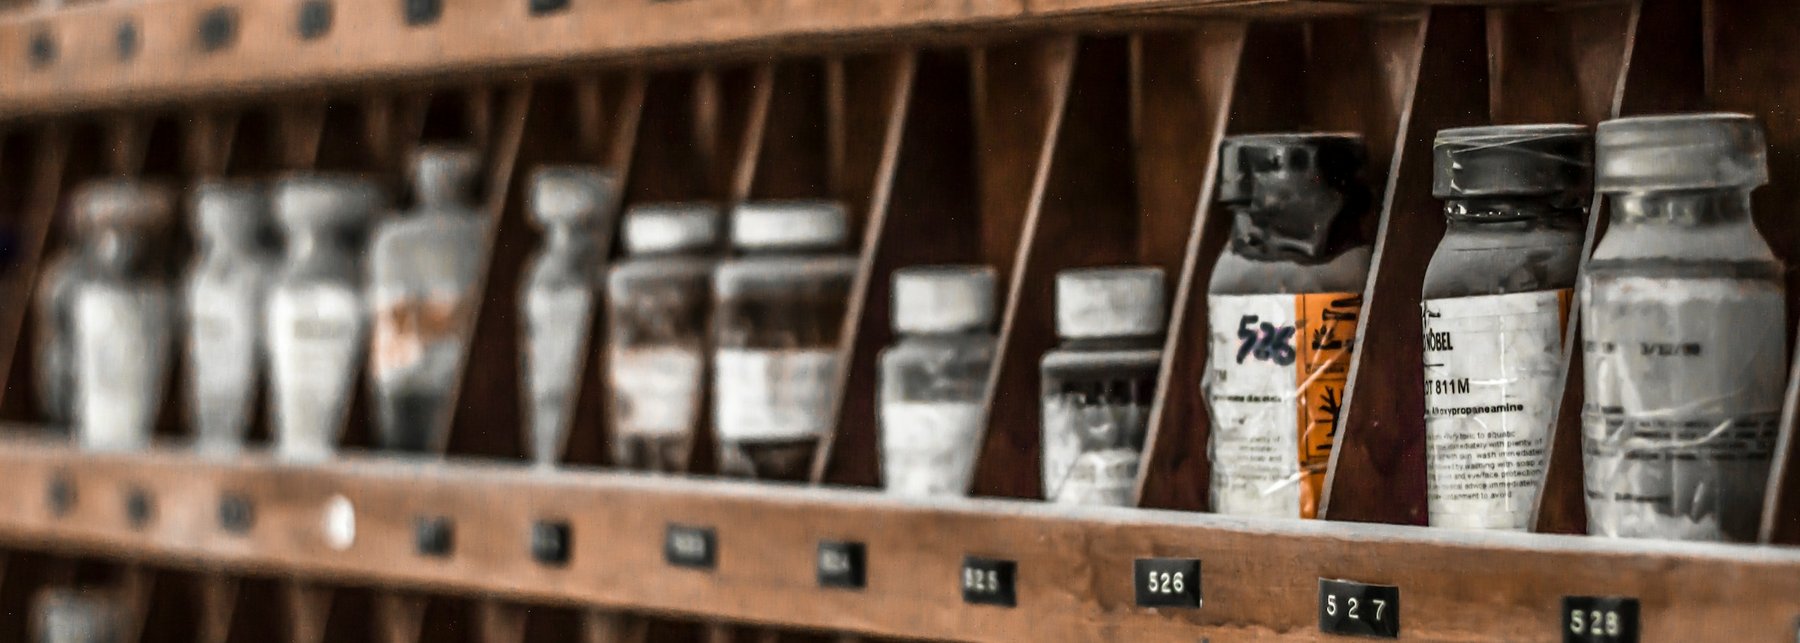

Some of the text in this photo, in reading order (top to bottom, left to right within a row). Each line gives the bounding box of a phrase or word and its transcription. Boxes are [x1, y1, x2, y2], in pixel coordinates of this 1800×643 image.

[1236, 314, 1296, 365] 526
[1435, 378, 1470, 395] 811M
[1148, 571, 1184, 593] 526
[1570, 609, 1620, 636] 528
